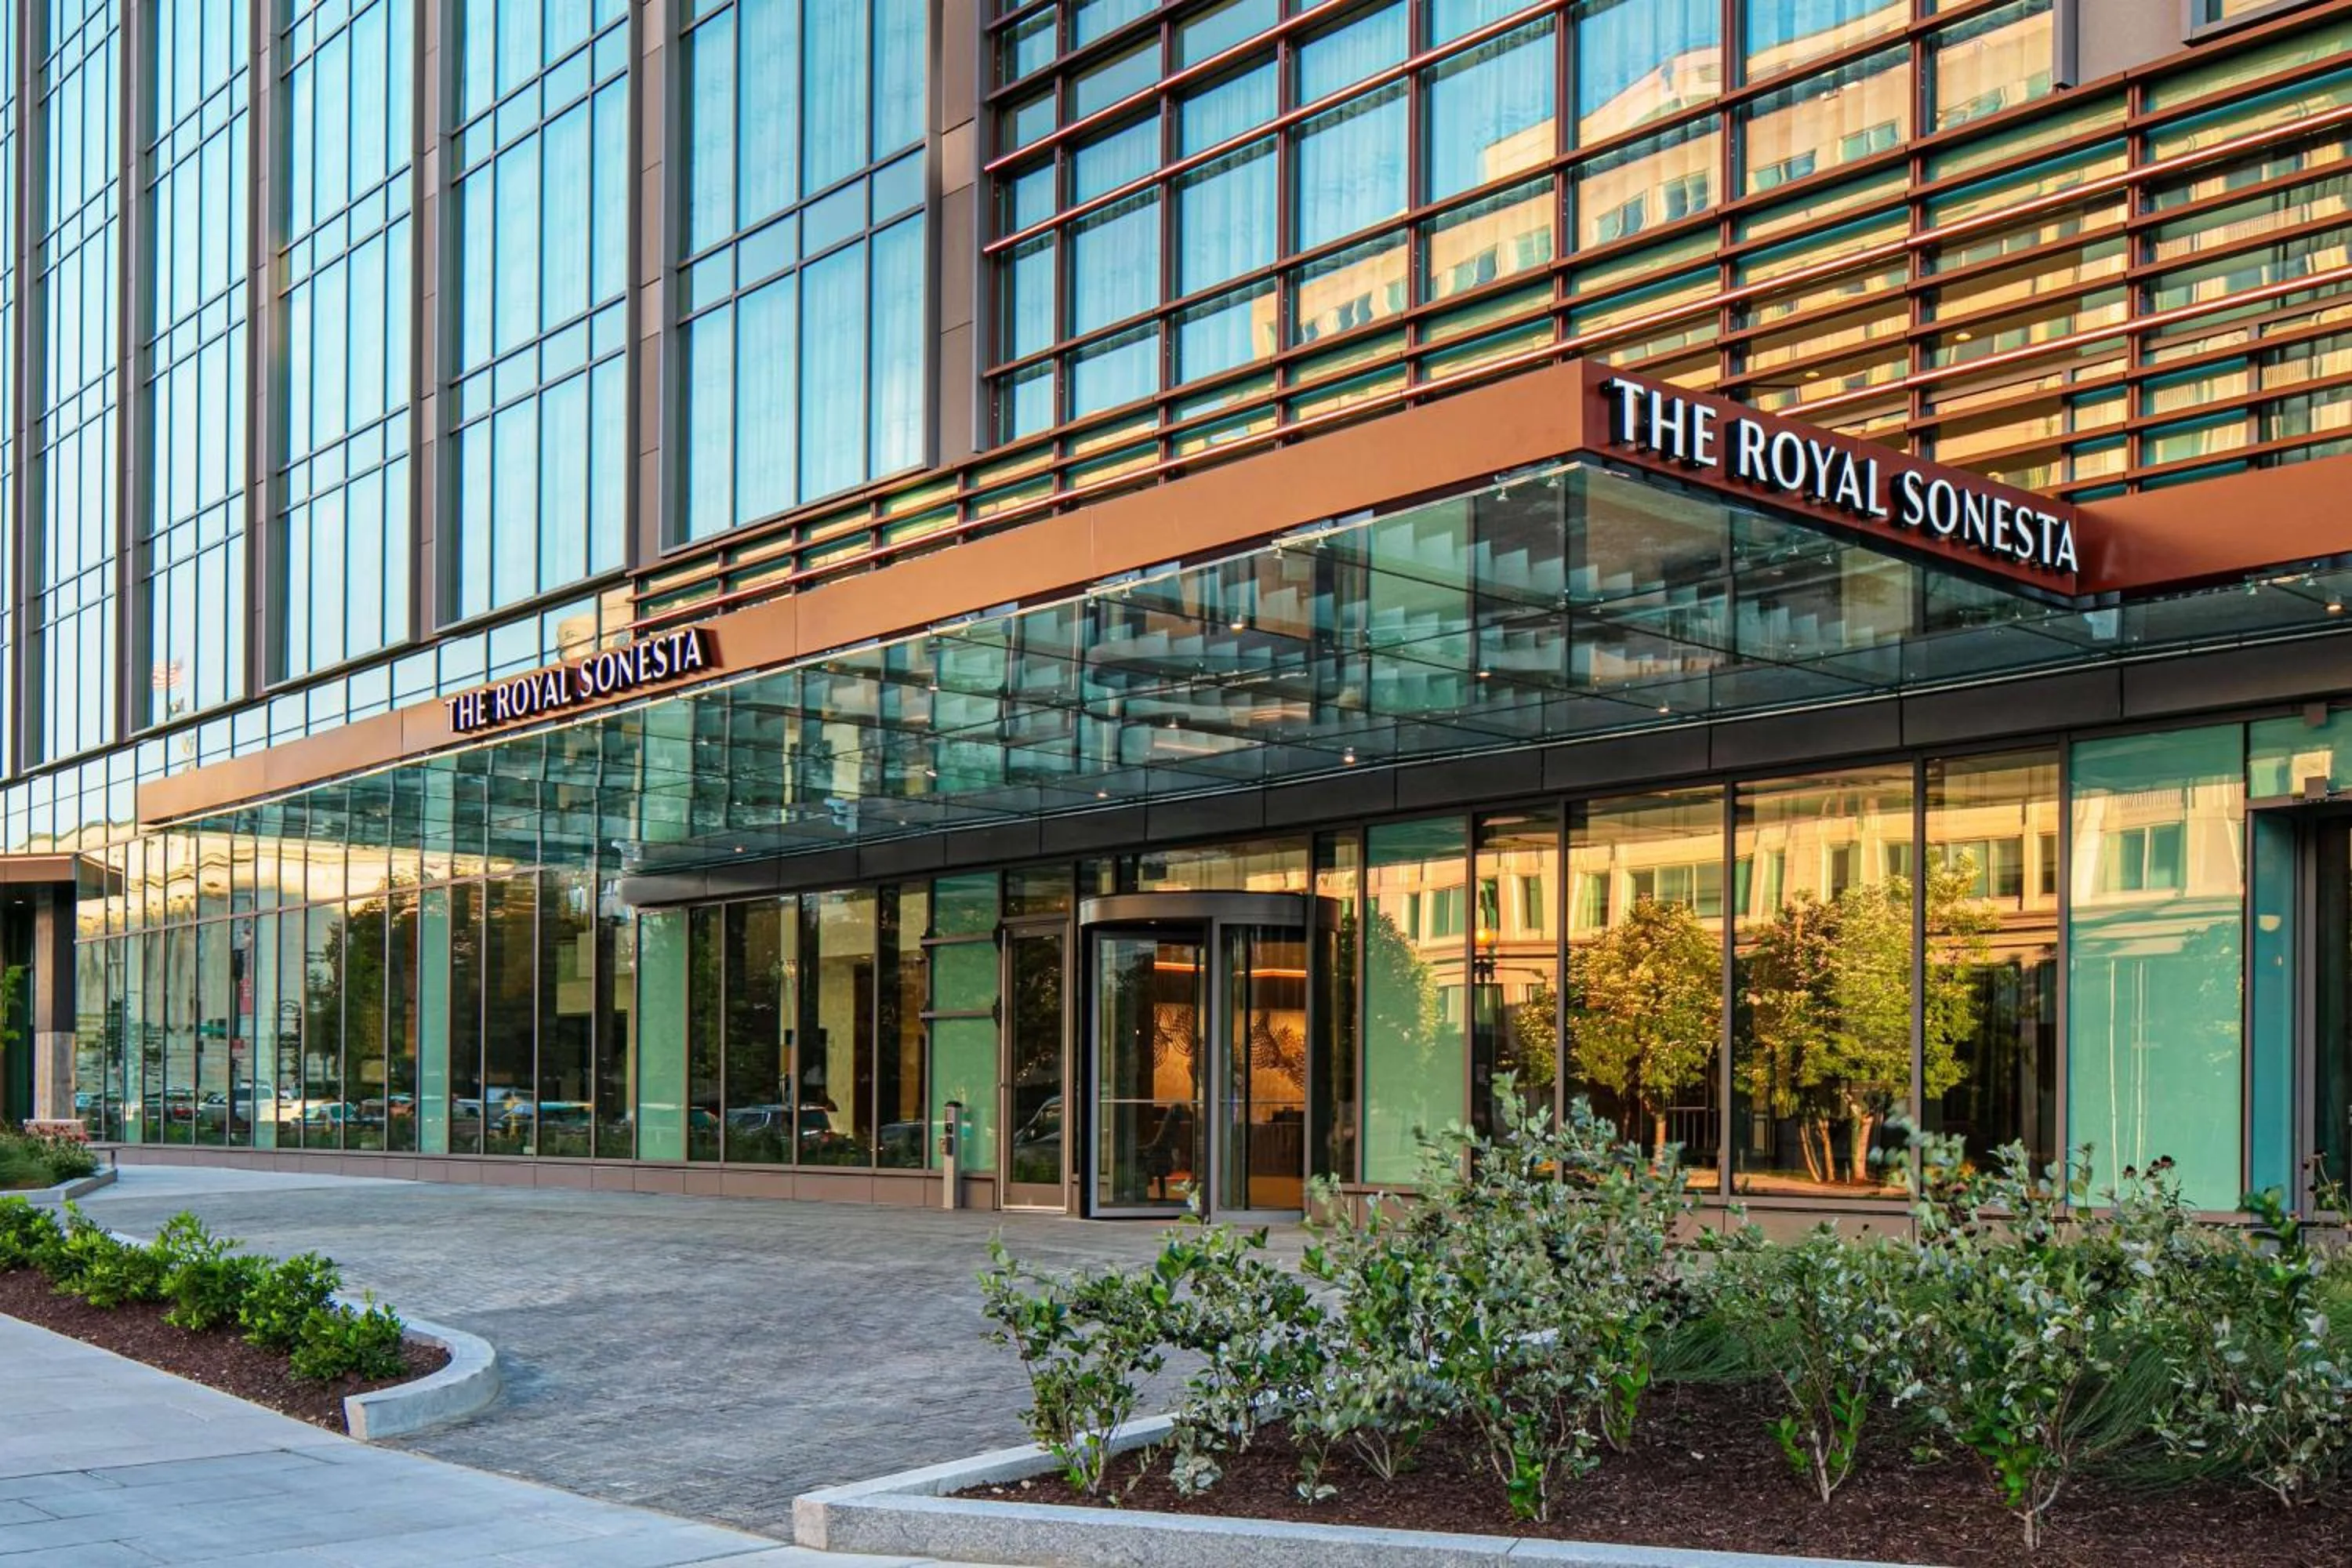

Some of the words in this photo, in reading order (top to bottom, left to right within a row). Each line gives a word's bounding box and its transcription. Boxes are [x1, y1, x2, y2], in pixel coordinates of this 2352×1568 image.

[1612, 379, 1718, 466] THE
[1739, 418, 1888, 517] ROYAL
[1902, 470, 2079, 572] SONESTA
[445, 689, 487, 732] THE
[495, 667, 572, 720] ROYAL
[579, 628, 703, 698] SONESTA
